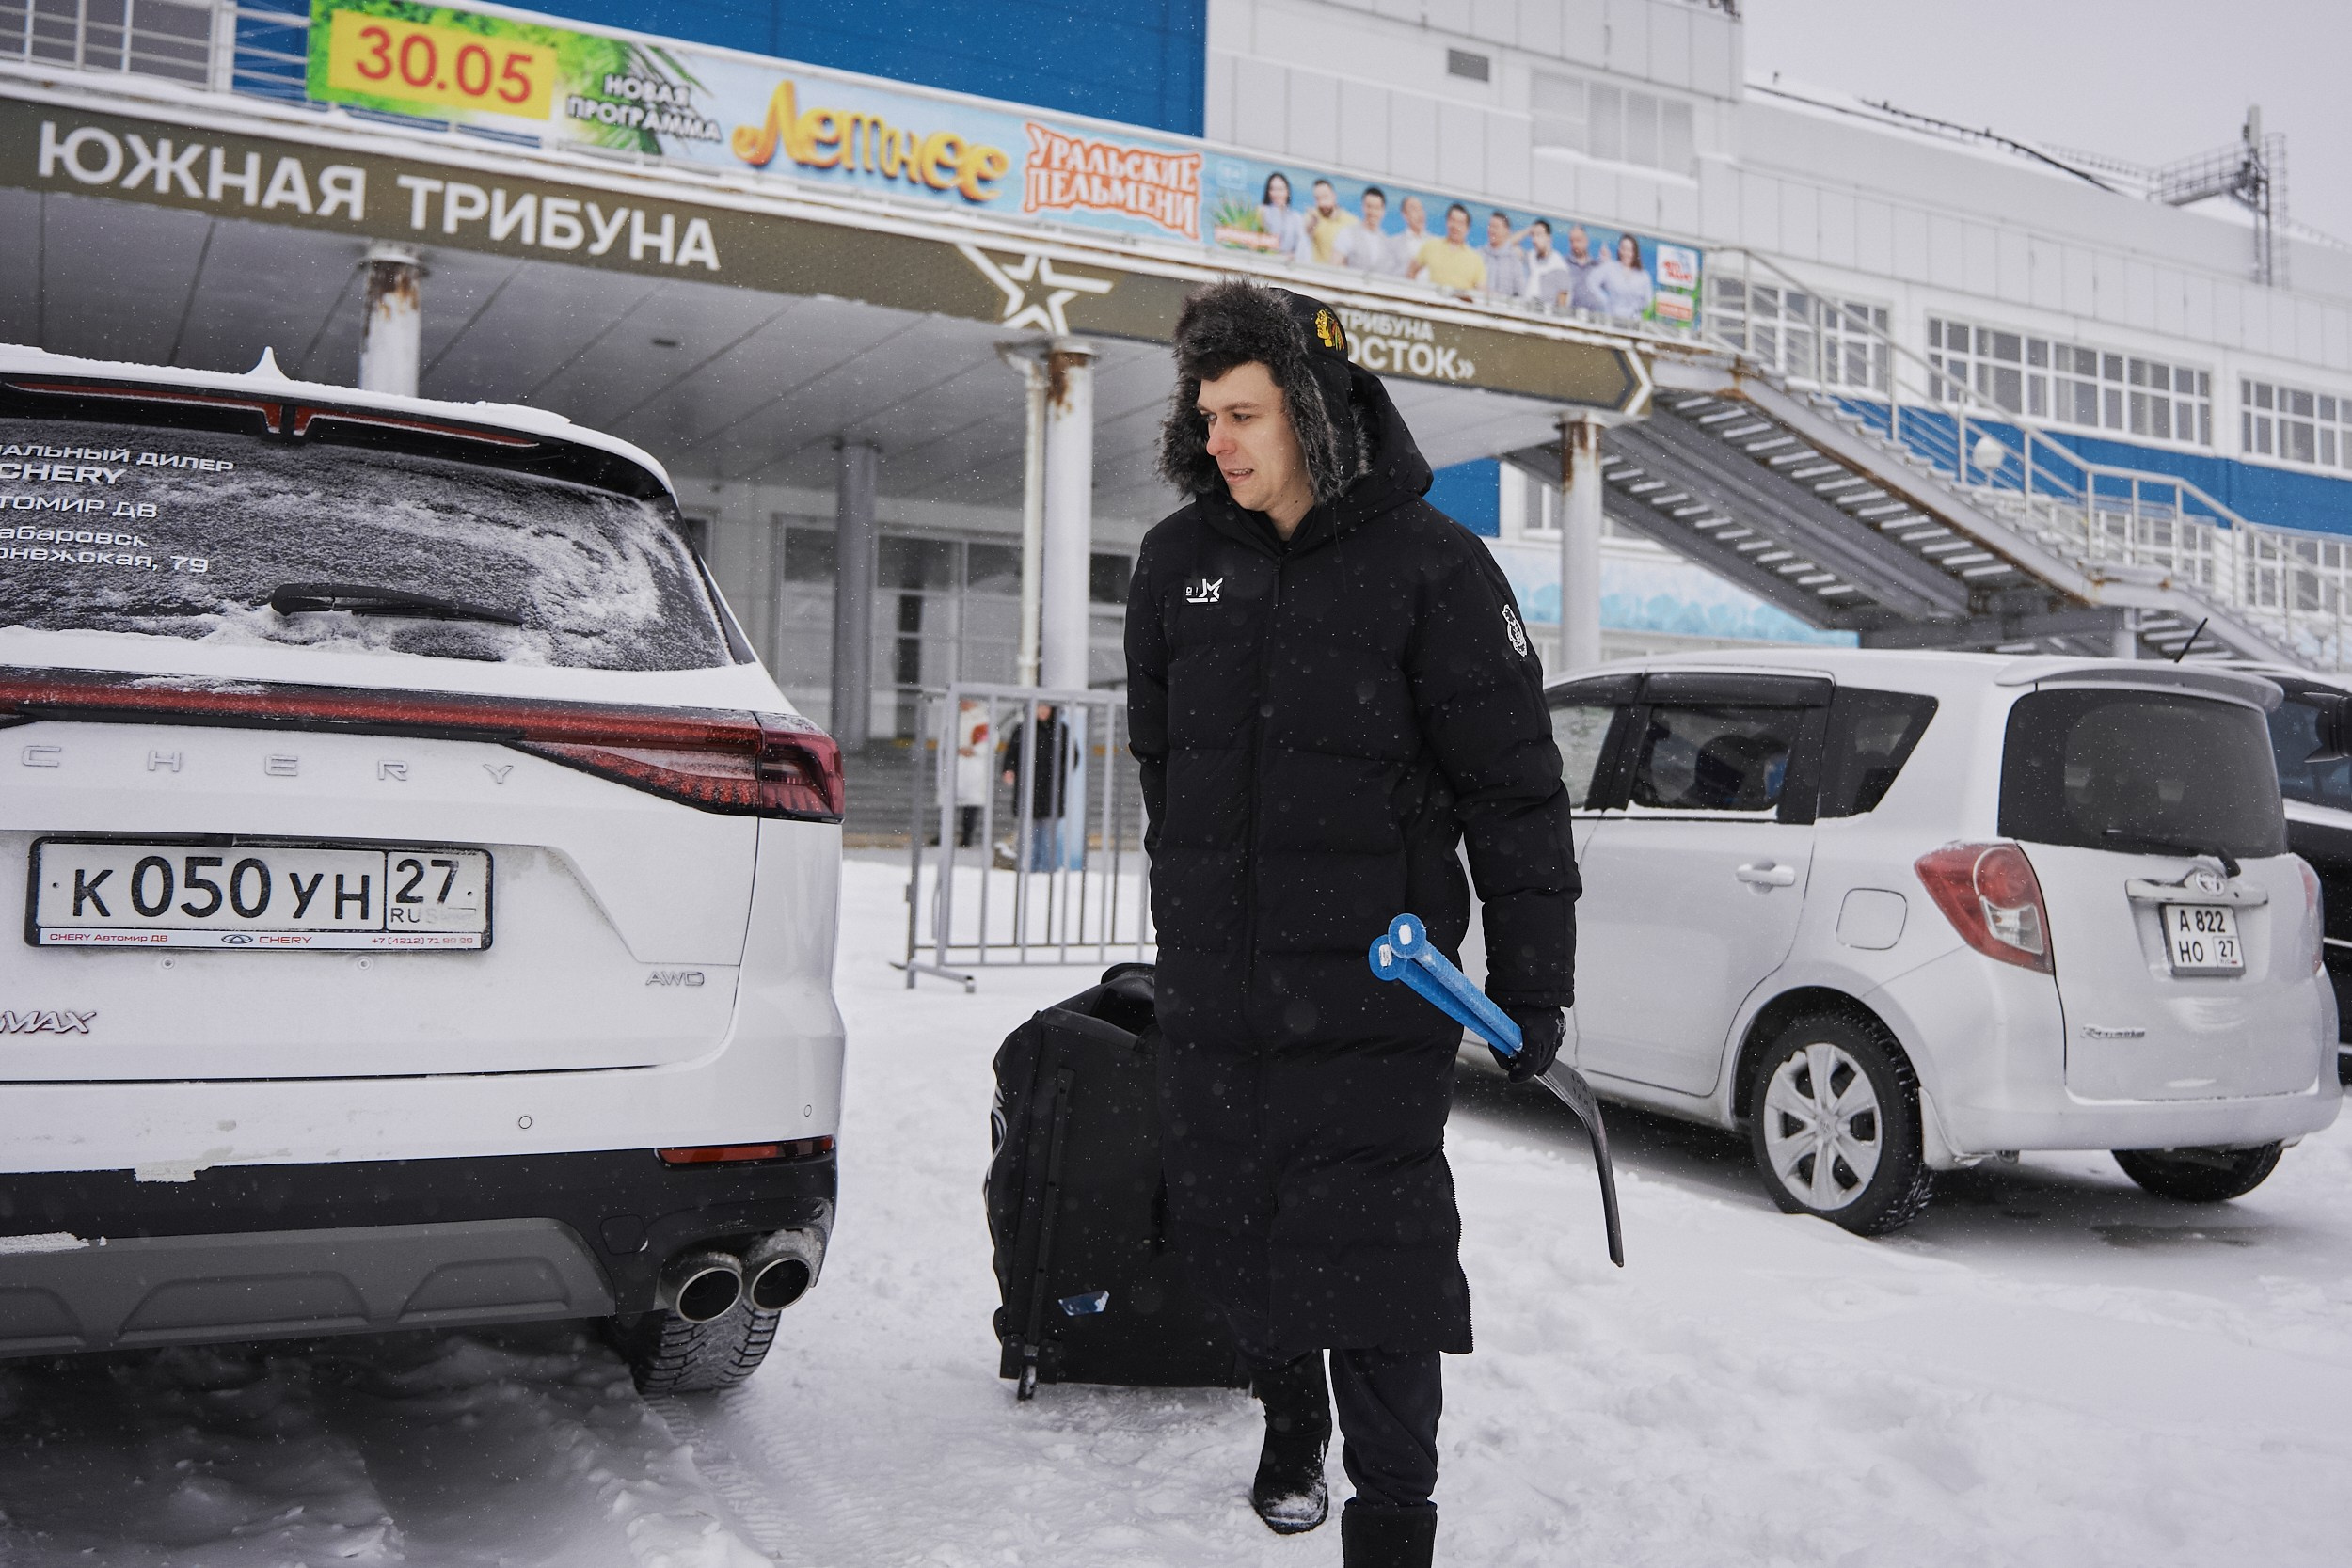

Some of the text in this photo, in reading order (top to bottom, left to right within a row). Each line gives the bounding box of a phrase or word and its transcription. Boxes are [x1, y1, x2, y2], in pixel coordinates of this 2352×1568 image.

[356, 25, 534, 104] 30.05
[604, 73, 690, 106] НОВАЯ
[567, 94, 723, 142] ПРОГРАММА
[732, 79, 1009, 201] Летнее
[1029, 125, 1199, 191] УРАЛЬСКИЕ
[38, 121, 721, 271] ЮЖНАЯ ТРИБУНА
[1027, 167, 1199, 237] ПЕЛЬМЕНИ
[1337, 308, 1435, 342] ТРИБУНА
[0, 444, 234, 472] АЛЬНЫЙ ДИЛЕР
[0, 463, 127, 484] CHERY
[112, 501, 157, 518] ДВ
[0, 526, 150, 547] абаровск
[170, 555, 209, 573] 79
[21, 745, 514, 784] CHERY
[396, 858, 459, 904] 27
[2195, 910, 2226, 933] 822
[94, 933, 148, 942] Автомир
[151, 934, 168, 942] ДВ
[259, 936, 312, 944] CHERY
[2179, 940, 2233, 963] НО 27
[645, 971, 704, 986] AWD
[0, 1010, 97, 1034] MAX
